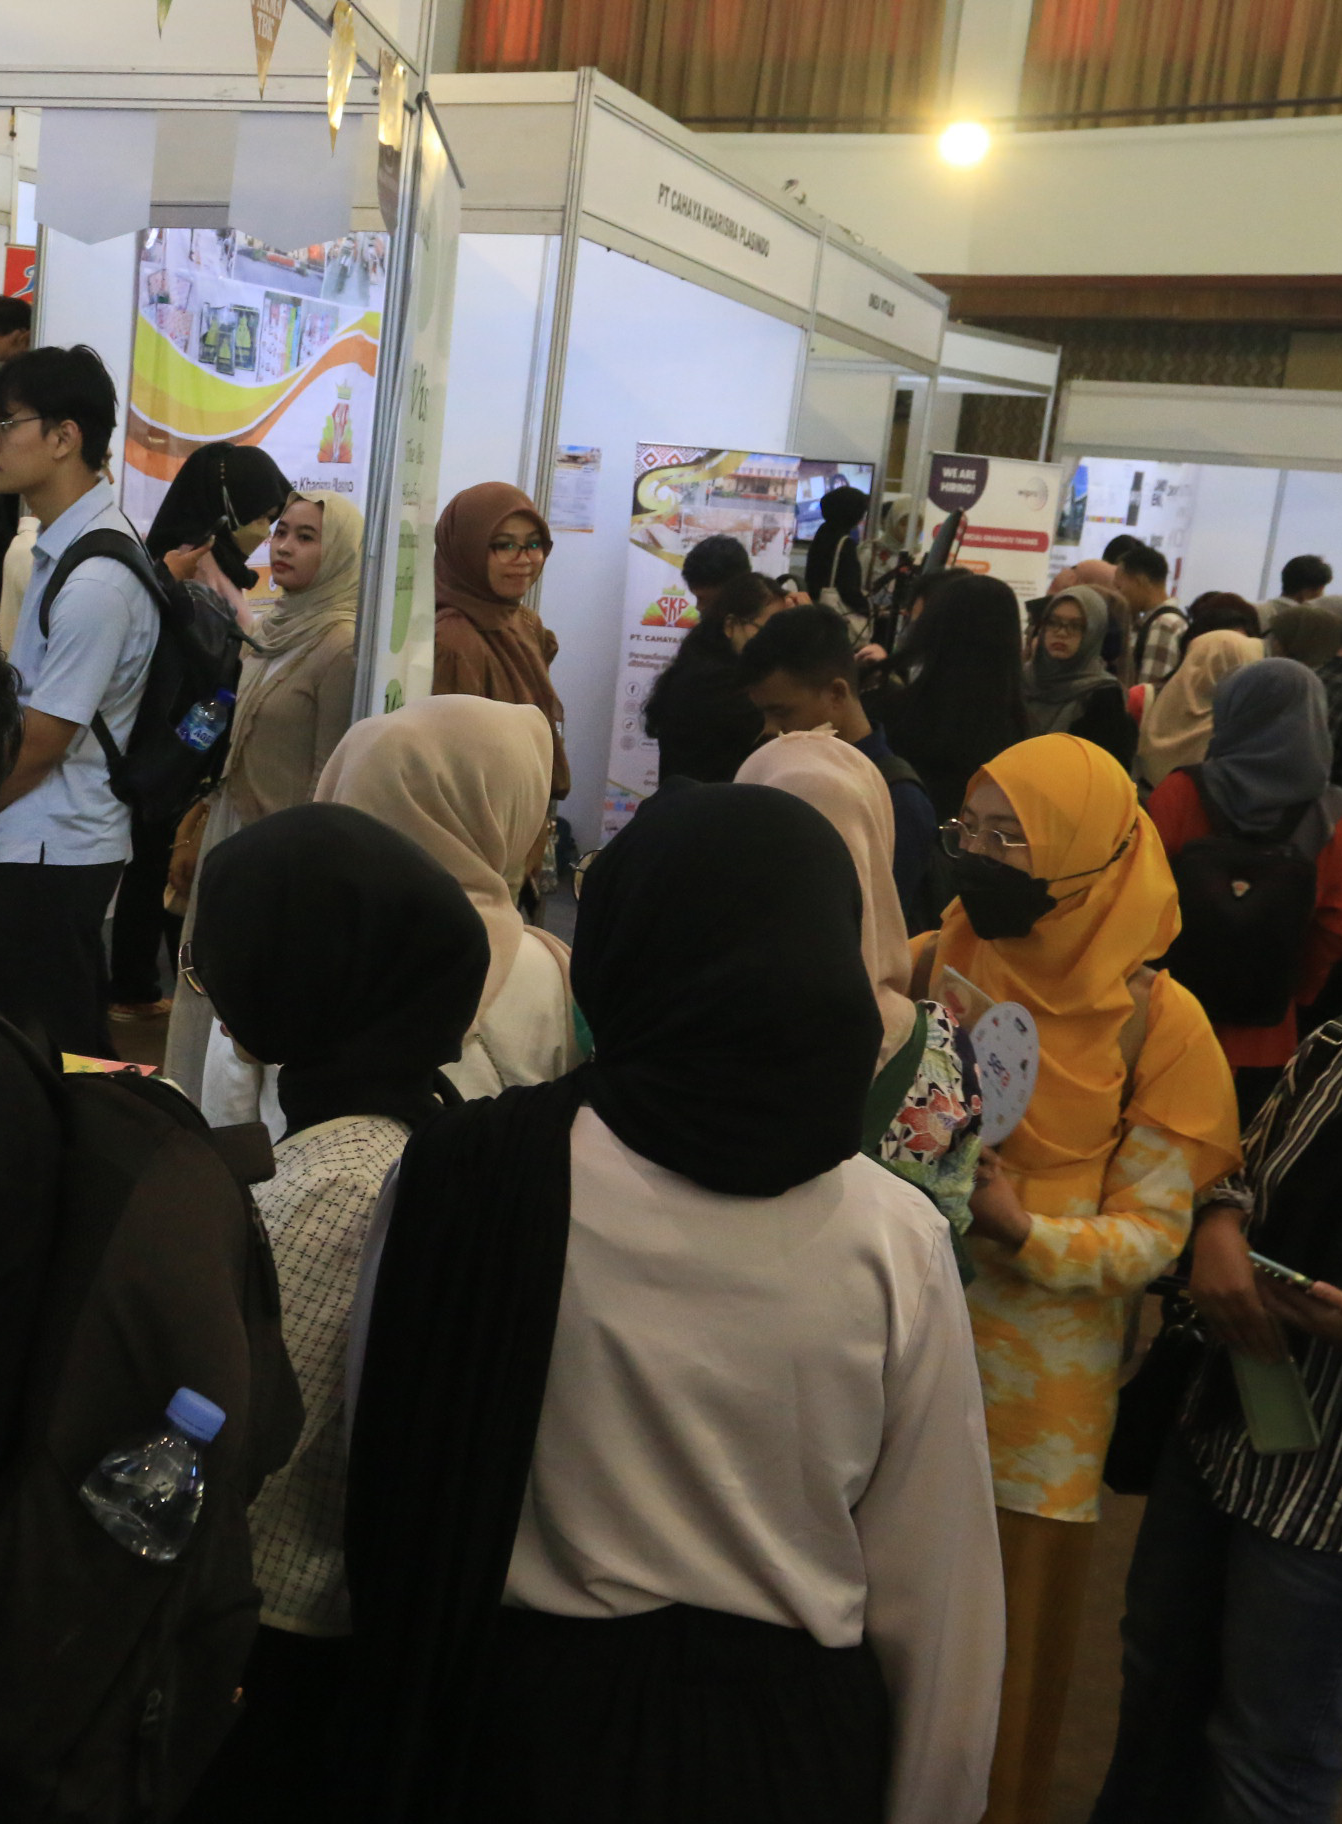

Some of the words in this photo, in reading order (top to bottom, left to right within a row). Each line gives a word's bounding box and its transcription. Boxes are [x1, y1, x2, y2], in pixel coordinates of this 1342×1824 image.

[658, 183, 670, 207] PT
[671, 190, 701, 223] CAHAYA
[942, 467, 958, 478] WE
[959, 469, 977, 480] ARE
[940, 482, 976, 494] HIRING!
